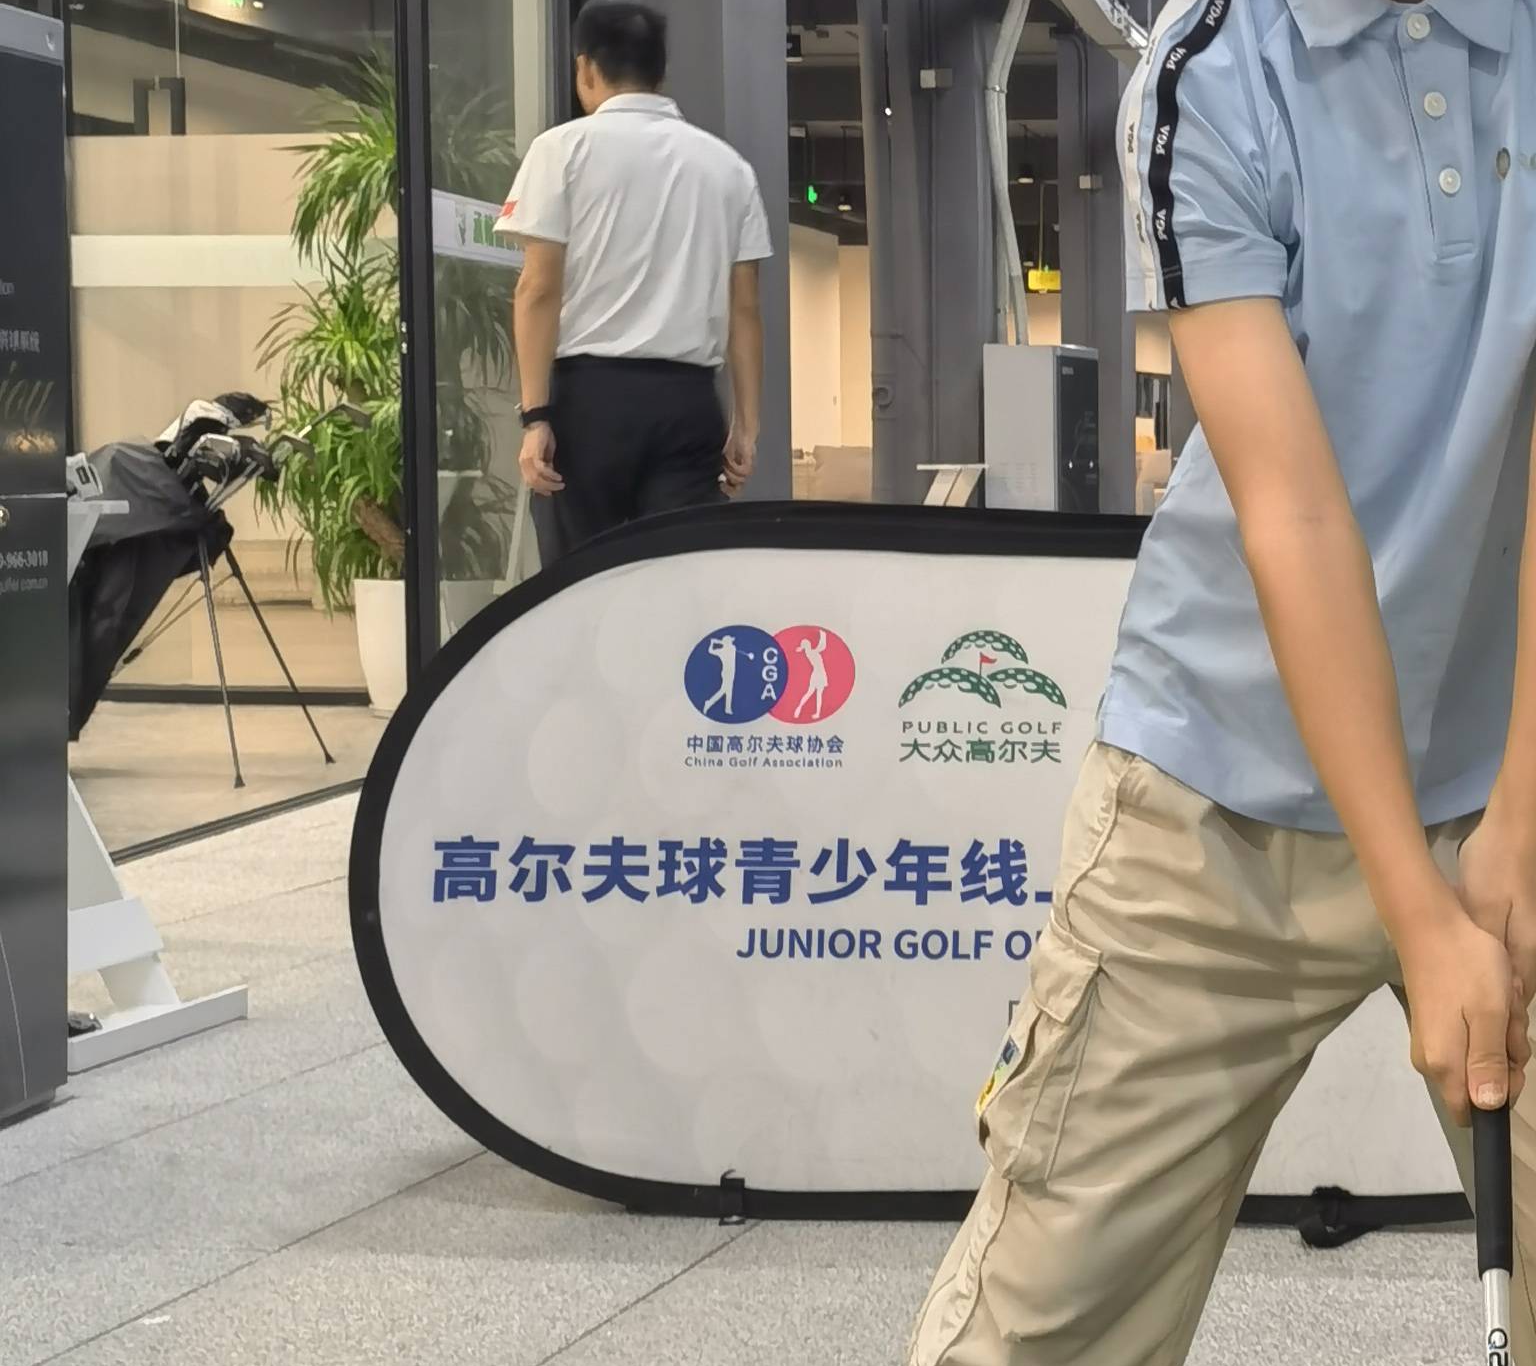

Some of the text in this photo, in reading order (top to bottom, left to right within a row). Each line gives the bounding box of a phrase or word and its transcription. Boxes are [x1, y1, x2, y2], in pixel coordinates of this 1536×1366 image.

[1165, 46, 1188, 72] PGA
[1155, 124, 1171, 156] PGA
[1154, 208, 1168, 242] PGA
[761, 647, 778, 700] CGA
[902, 721, 1062, 735] PUBLIC GOLF
[686, 734, 844, 754] 中国高尔夫球协会
[899, 737, 1063, 764] 大众高尔夫
[684, 756, 844, 769] China Golf Association
[736, 928, 882, 959] JUNIOR
[893, 929, 995, 960] GOLF
